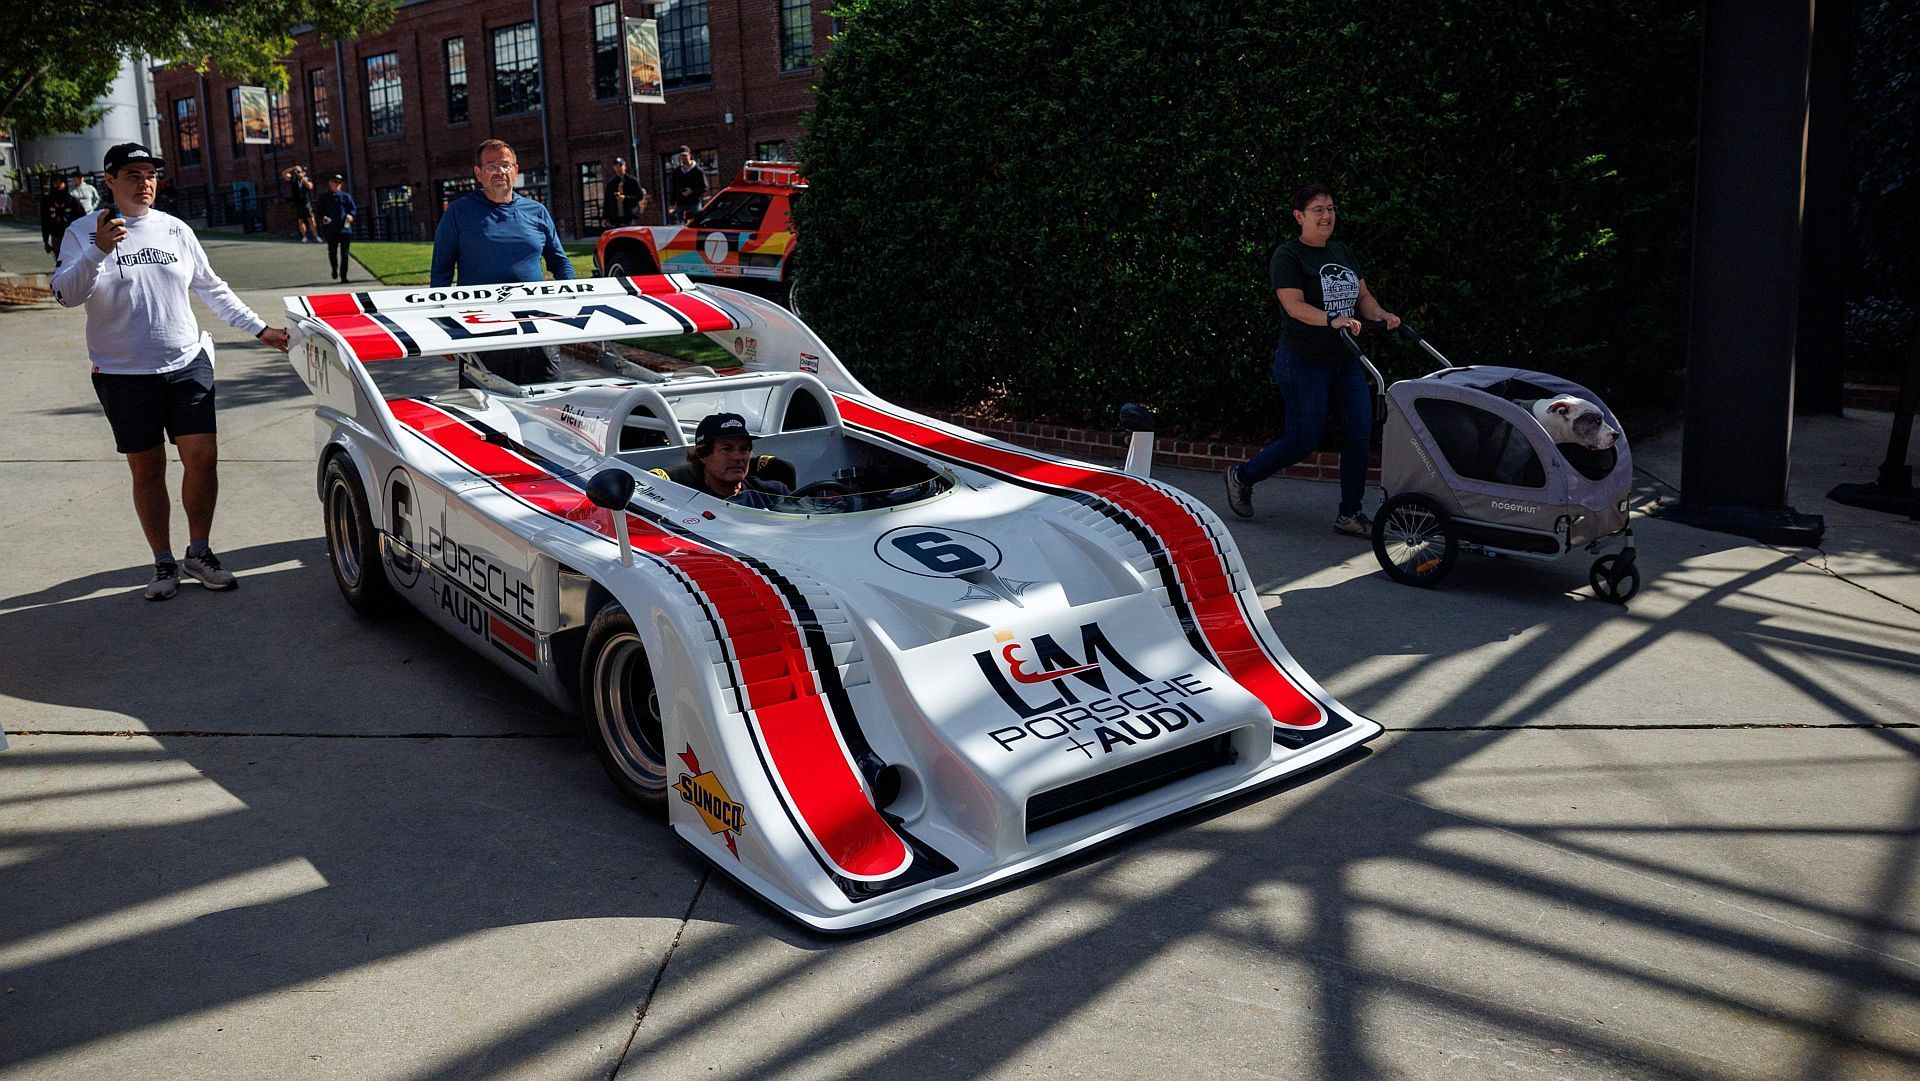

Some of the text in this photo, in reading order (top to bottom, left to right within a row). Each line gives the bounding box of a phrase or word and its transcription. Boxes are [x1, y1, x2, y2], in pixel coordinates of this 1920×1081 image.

[405, 283, 595, 304] GOOD YEAR
[392, 480, 413, 575] 6
[891, 531, 987, 573] 6
[429, 525, 535, 626] PORSCHE
[987, 673, 1213, 752] PORSCHE
[681, 775, 742, 832] SUNOCO
